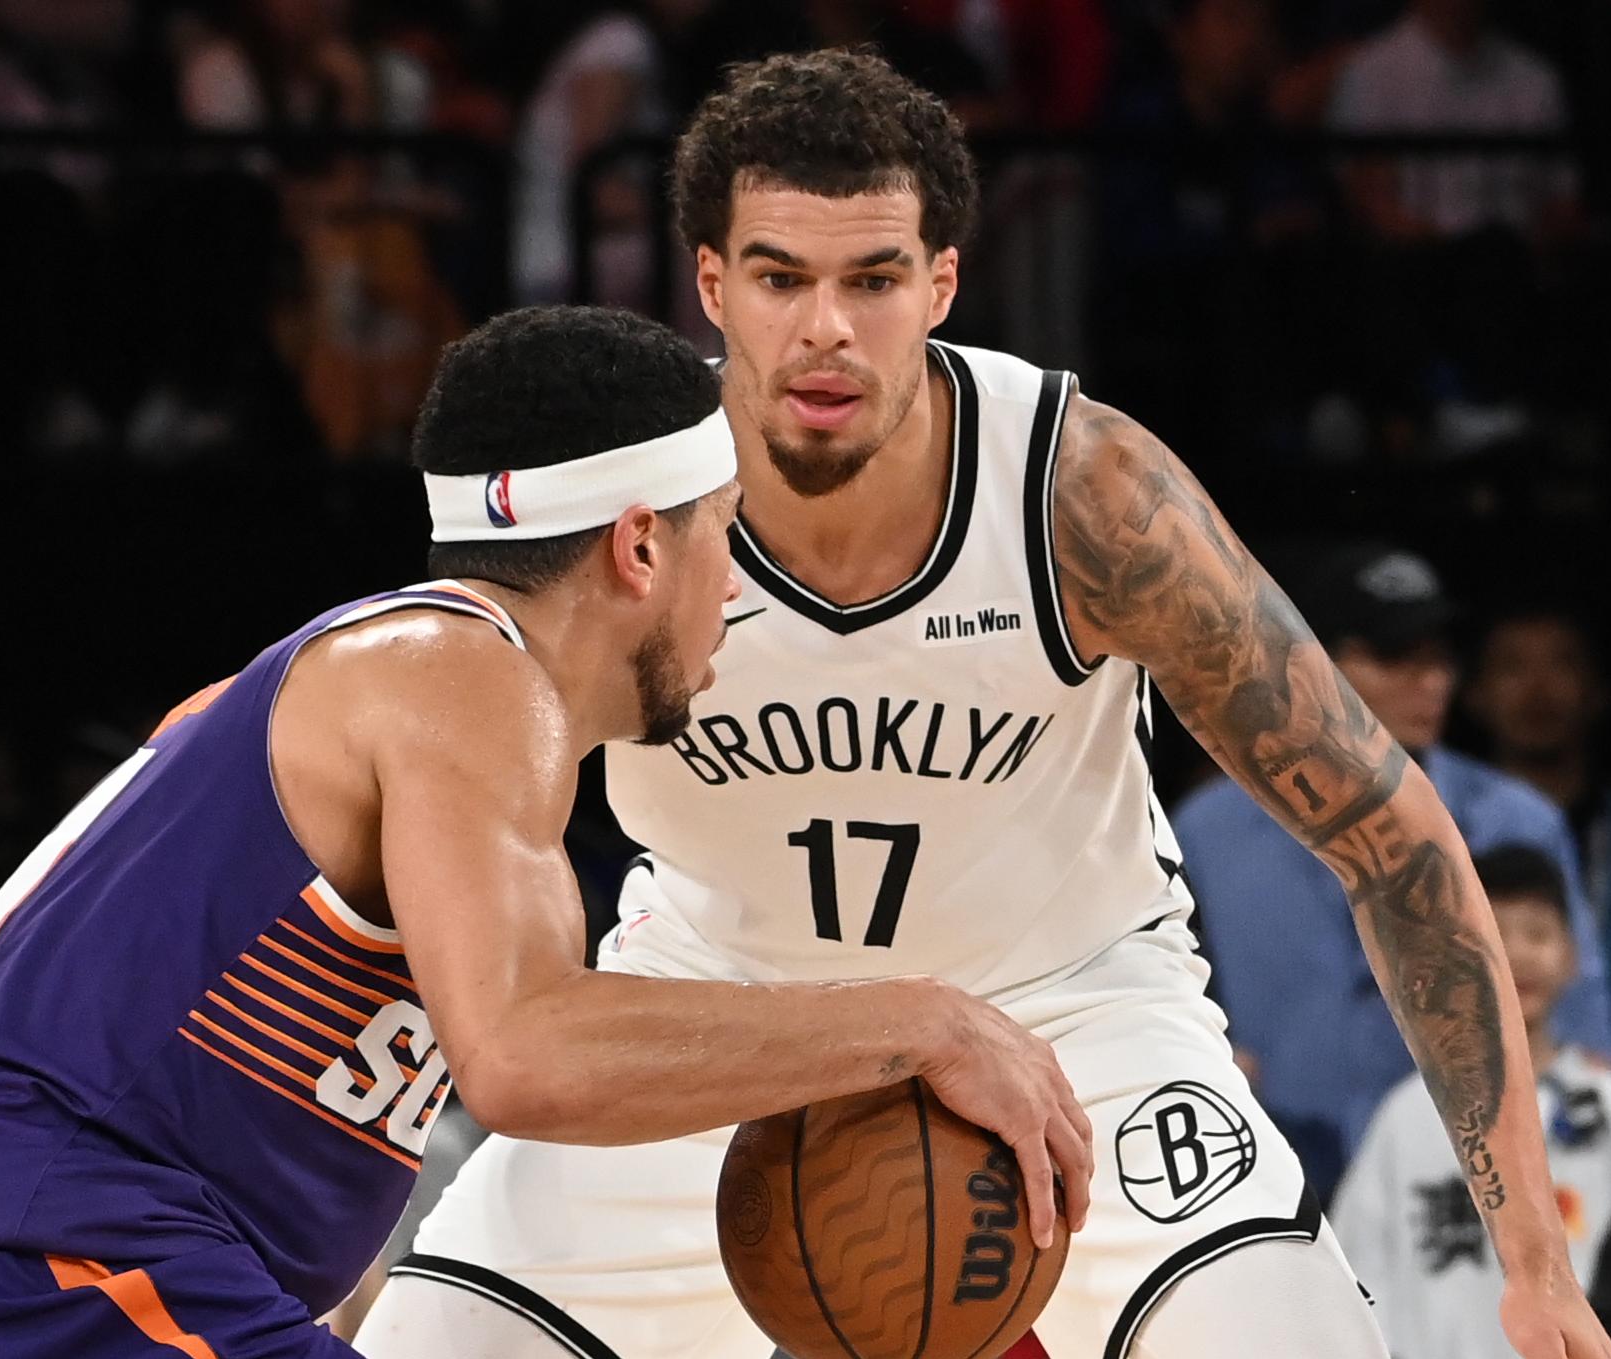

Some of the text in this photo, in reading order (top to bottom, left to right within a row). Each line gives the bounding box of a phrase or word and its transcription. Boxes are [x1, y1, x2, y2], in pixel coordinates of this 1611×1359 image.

[925, 608, 1021, 640] All In Won
[674, 696, 1055, 786] BROOKLYN
[787, 818, 921, 948] 17
[1155, 1102, 1209, 1200] B
